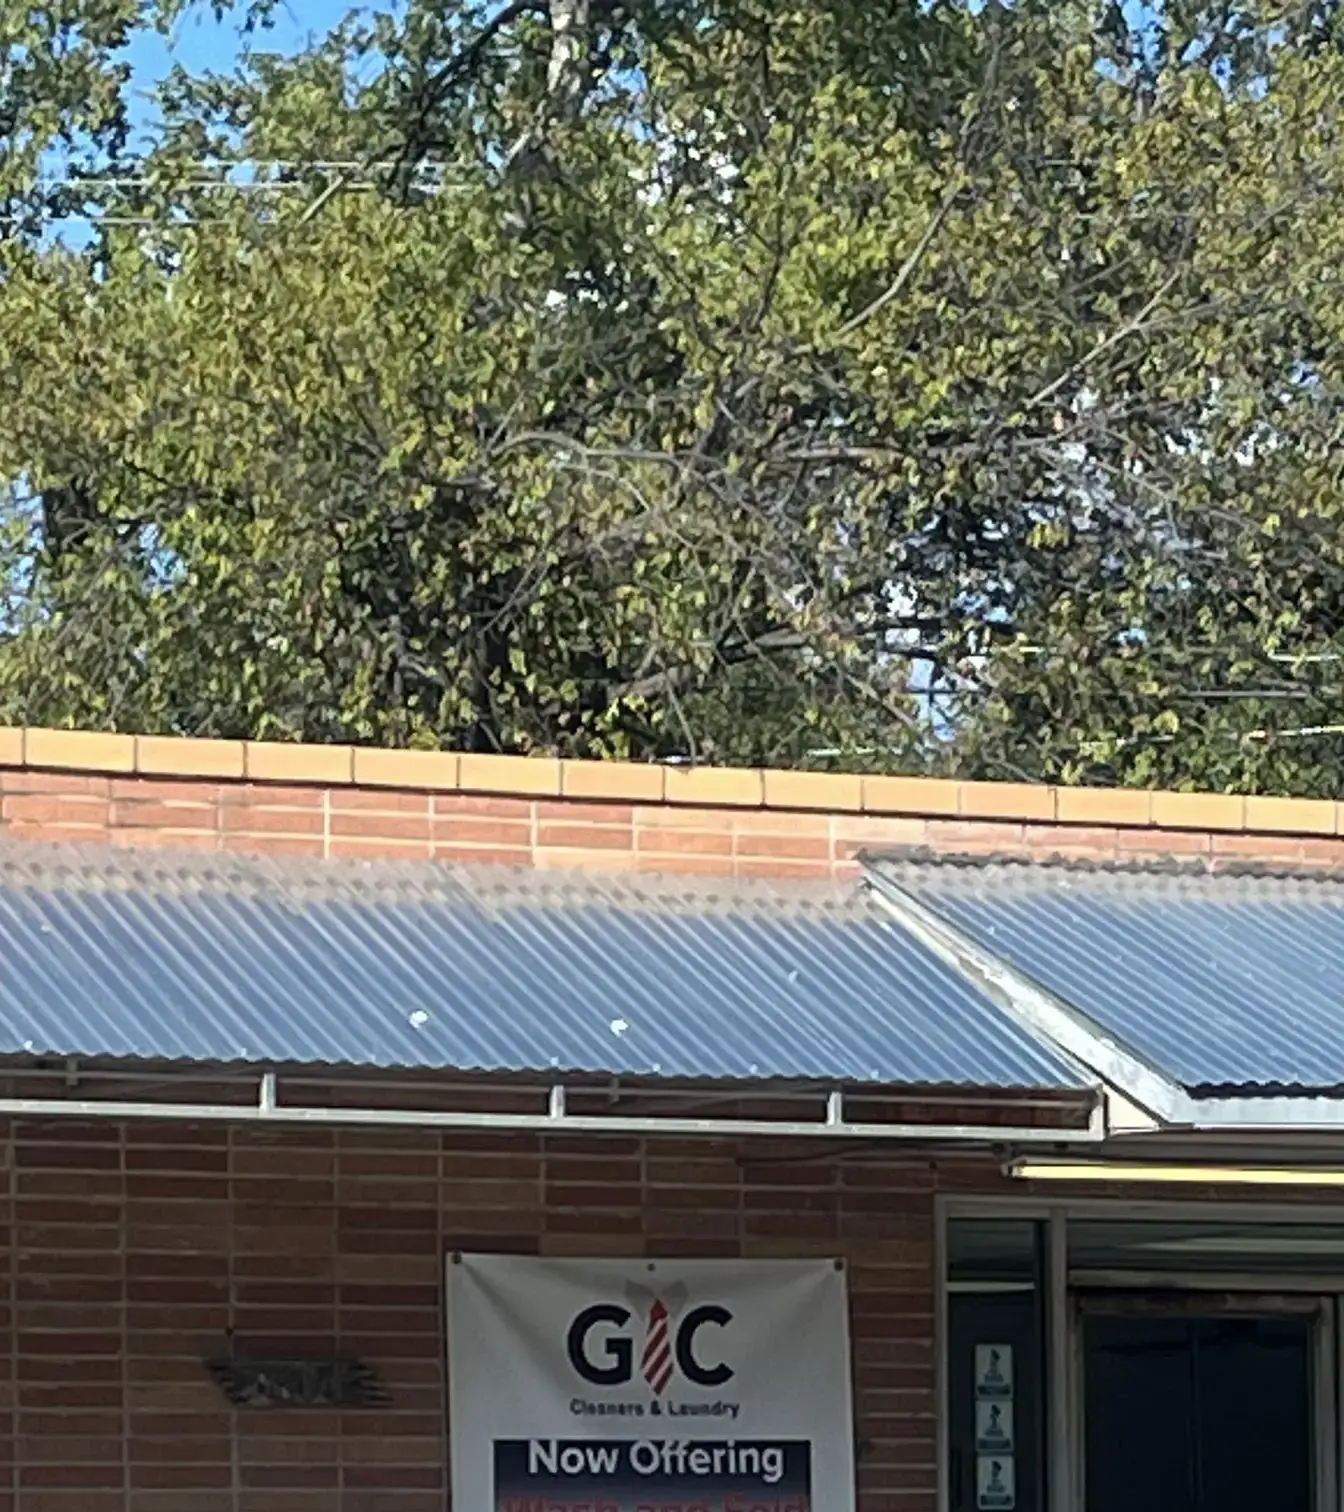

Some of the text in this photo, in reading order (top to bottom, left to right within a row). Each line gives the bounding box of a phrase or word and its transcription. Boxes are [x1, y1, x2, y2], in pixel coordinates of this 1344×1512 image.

[569, 1399, 644, 1415] Cleaners
[668, 1400, 740, 1419] Laundry
[528, 1438, 784, 1483] Now Offering
